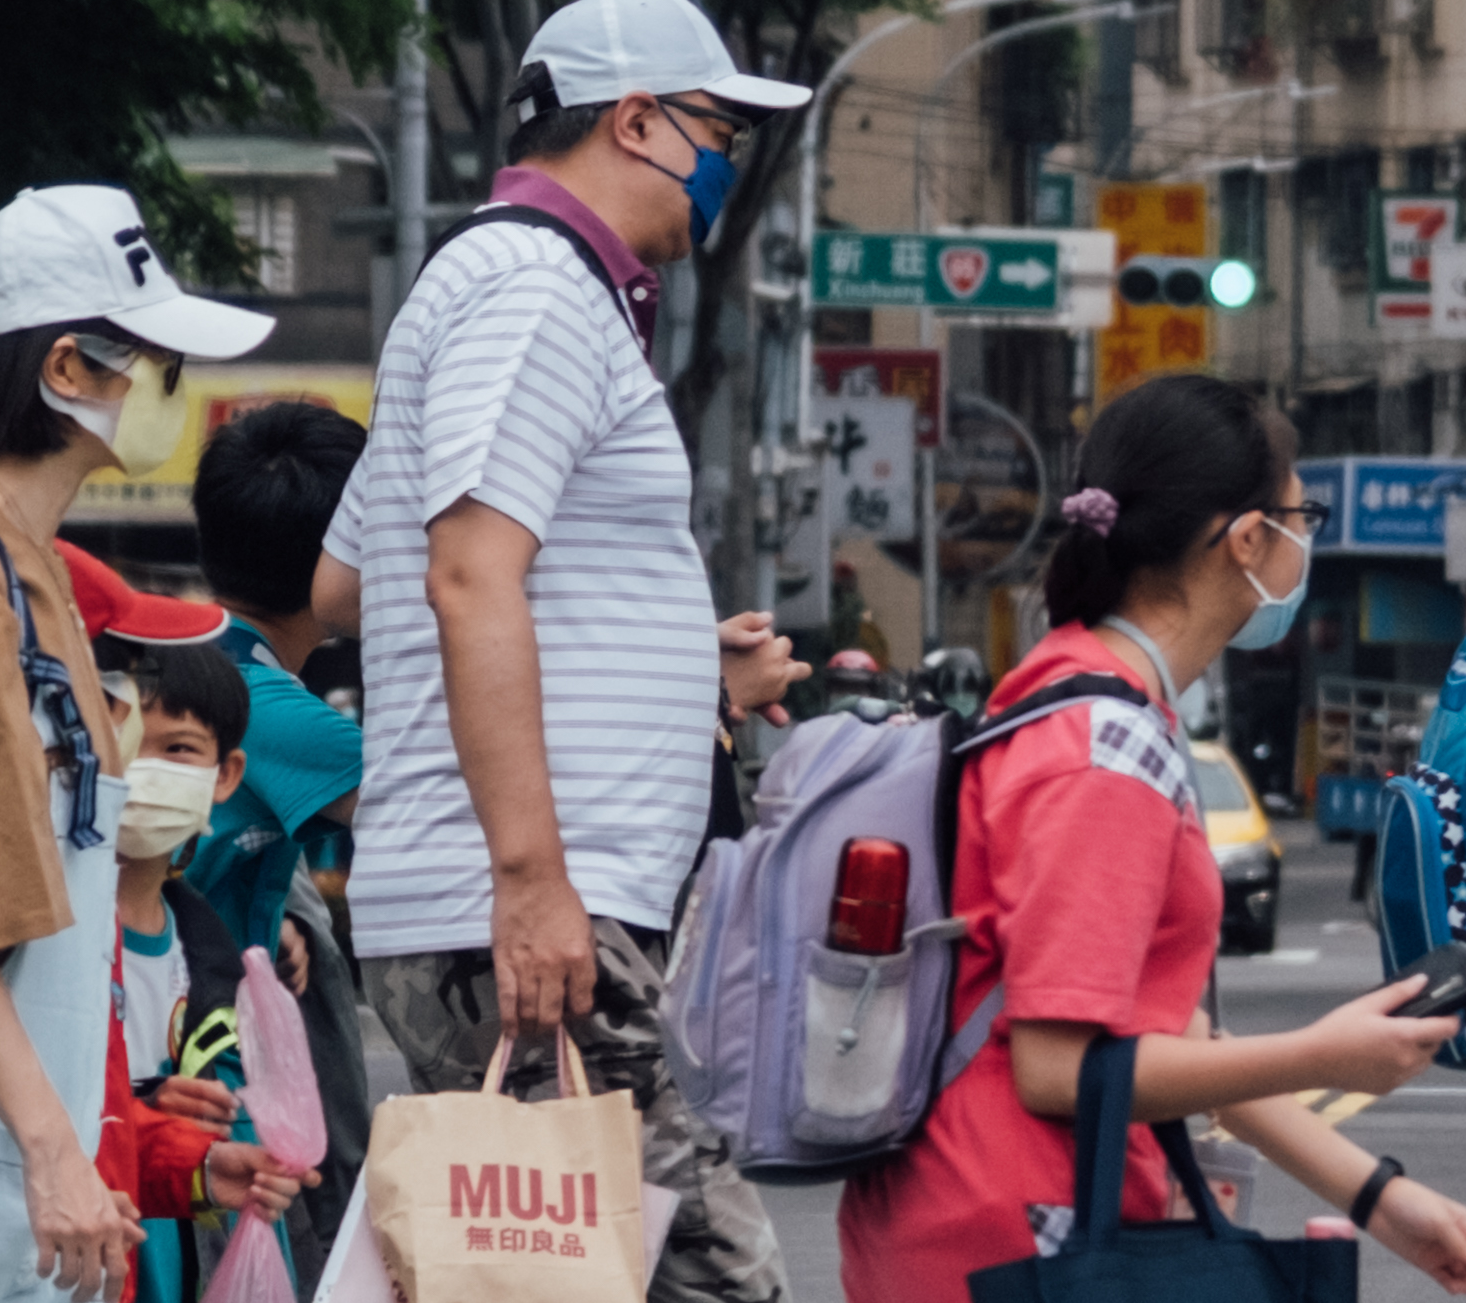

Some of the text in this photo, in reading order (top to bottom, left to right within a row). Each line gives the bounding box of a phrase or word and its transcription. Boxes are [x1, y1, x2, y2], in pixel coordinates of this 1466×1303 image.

[449, 1163, 597, 1228] MUJI
[465, 1224, 587, 1258] 無印良品
